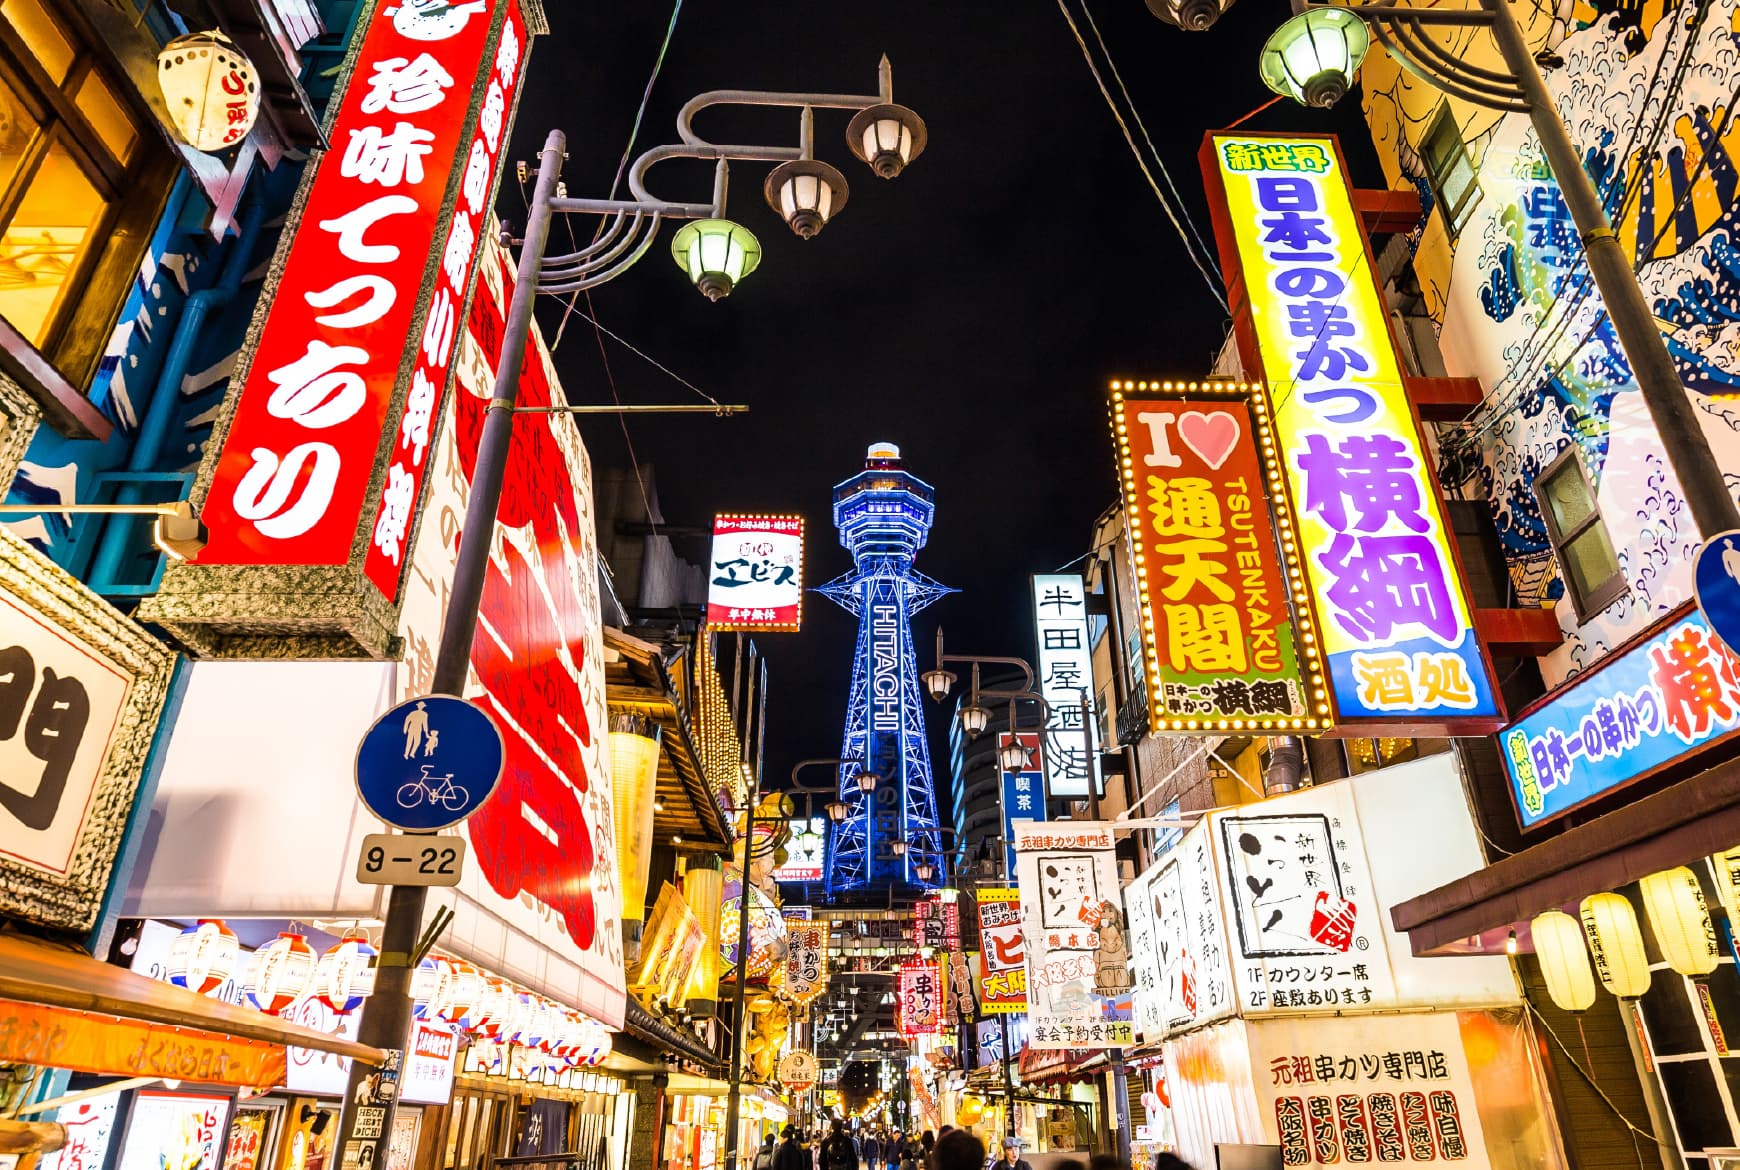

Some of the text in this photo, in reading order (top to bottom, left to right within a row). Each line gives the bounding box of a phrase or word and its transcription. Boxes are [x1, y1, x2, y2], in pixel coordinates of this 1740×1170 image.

[1227, 143, 1330, 172] 新世界
[233, 52, 455, 540] 珍味てっちり
[1255, 176, 1378, 425] 日本一の串かつ
[1297, 433, 1460, 648] 横綱
[1147, 476, 1251, 671] 通天閣
[1224, 476, 1282, 670] TSUTENKAKU
[728, 608, 776, 620] 年中無休
[873, 605, 900, 732] HITACHI
[1165, 684, 1211, 697] 日本一の
[1360, 656, 1470, 706] 酒処
[1168, 699, 1212, 713] 串かつ
[1212, 680, 1292, 715] 横綱
[1531, 690, 1660, 789] 日本一の串かつ
[1015, 777, 1033, 811] 喫茶
[1509, 732, 1541, 812] 新世界
[1020, 834, 1110, 849] 元祖串カツ専門店
[1295, 832, 1325, 889] 新世界
[980, 902, 1009, 918] 新世界
[802, 929, 821, 981] 串かつ
[983, 930, 997, 970] 大阪名物
[1247, 963, 1370, 983] 1F カウンター席
[915, 973, 934, 1017] 串かつ
[1250, 986, 1373, 1007] 2F 座敷あります
[1034, 1024, 1132, 1042] 宴会予約受付中
[1270, 1050, 1449, 1086] 元祖串カツ専門店
[358, 1108, 385, 1118] HECK
[1279, 1097, 1308, 1166] 大阪名物
[1311, 1098, 1339, 1164] 串カツ
[1340, 1095, 1369, 1163] どて焼き
[1371, 1094, 1402, 1162] 焼きそば
[1402, 1093, 1433, 1160] たこ焼き
[1433, 1092, 1466, 1159] 味自慢
